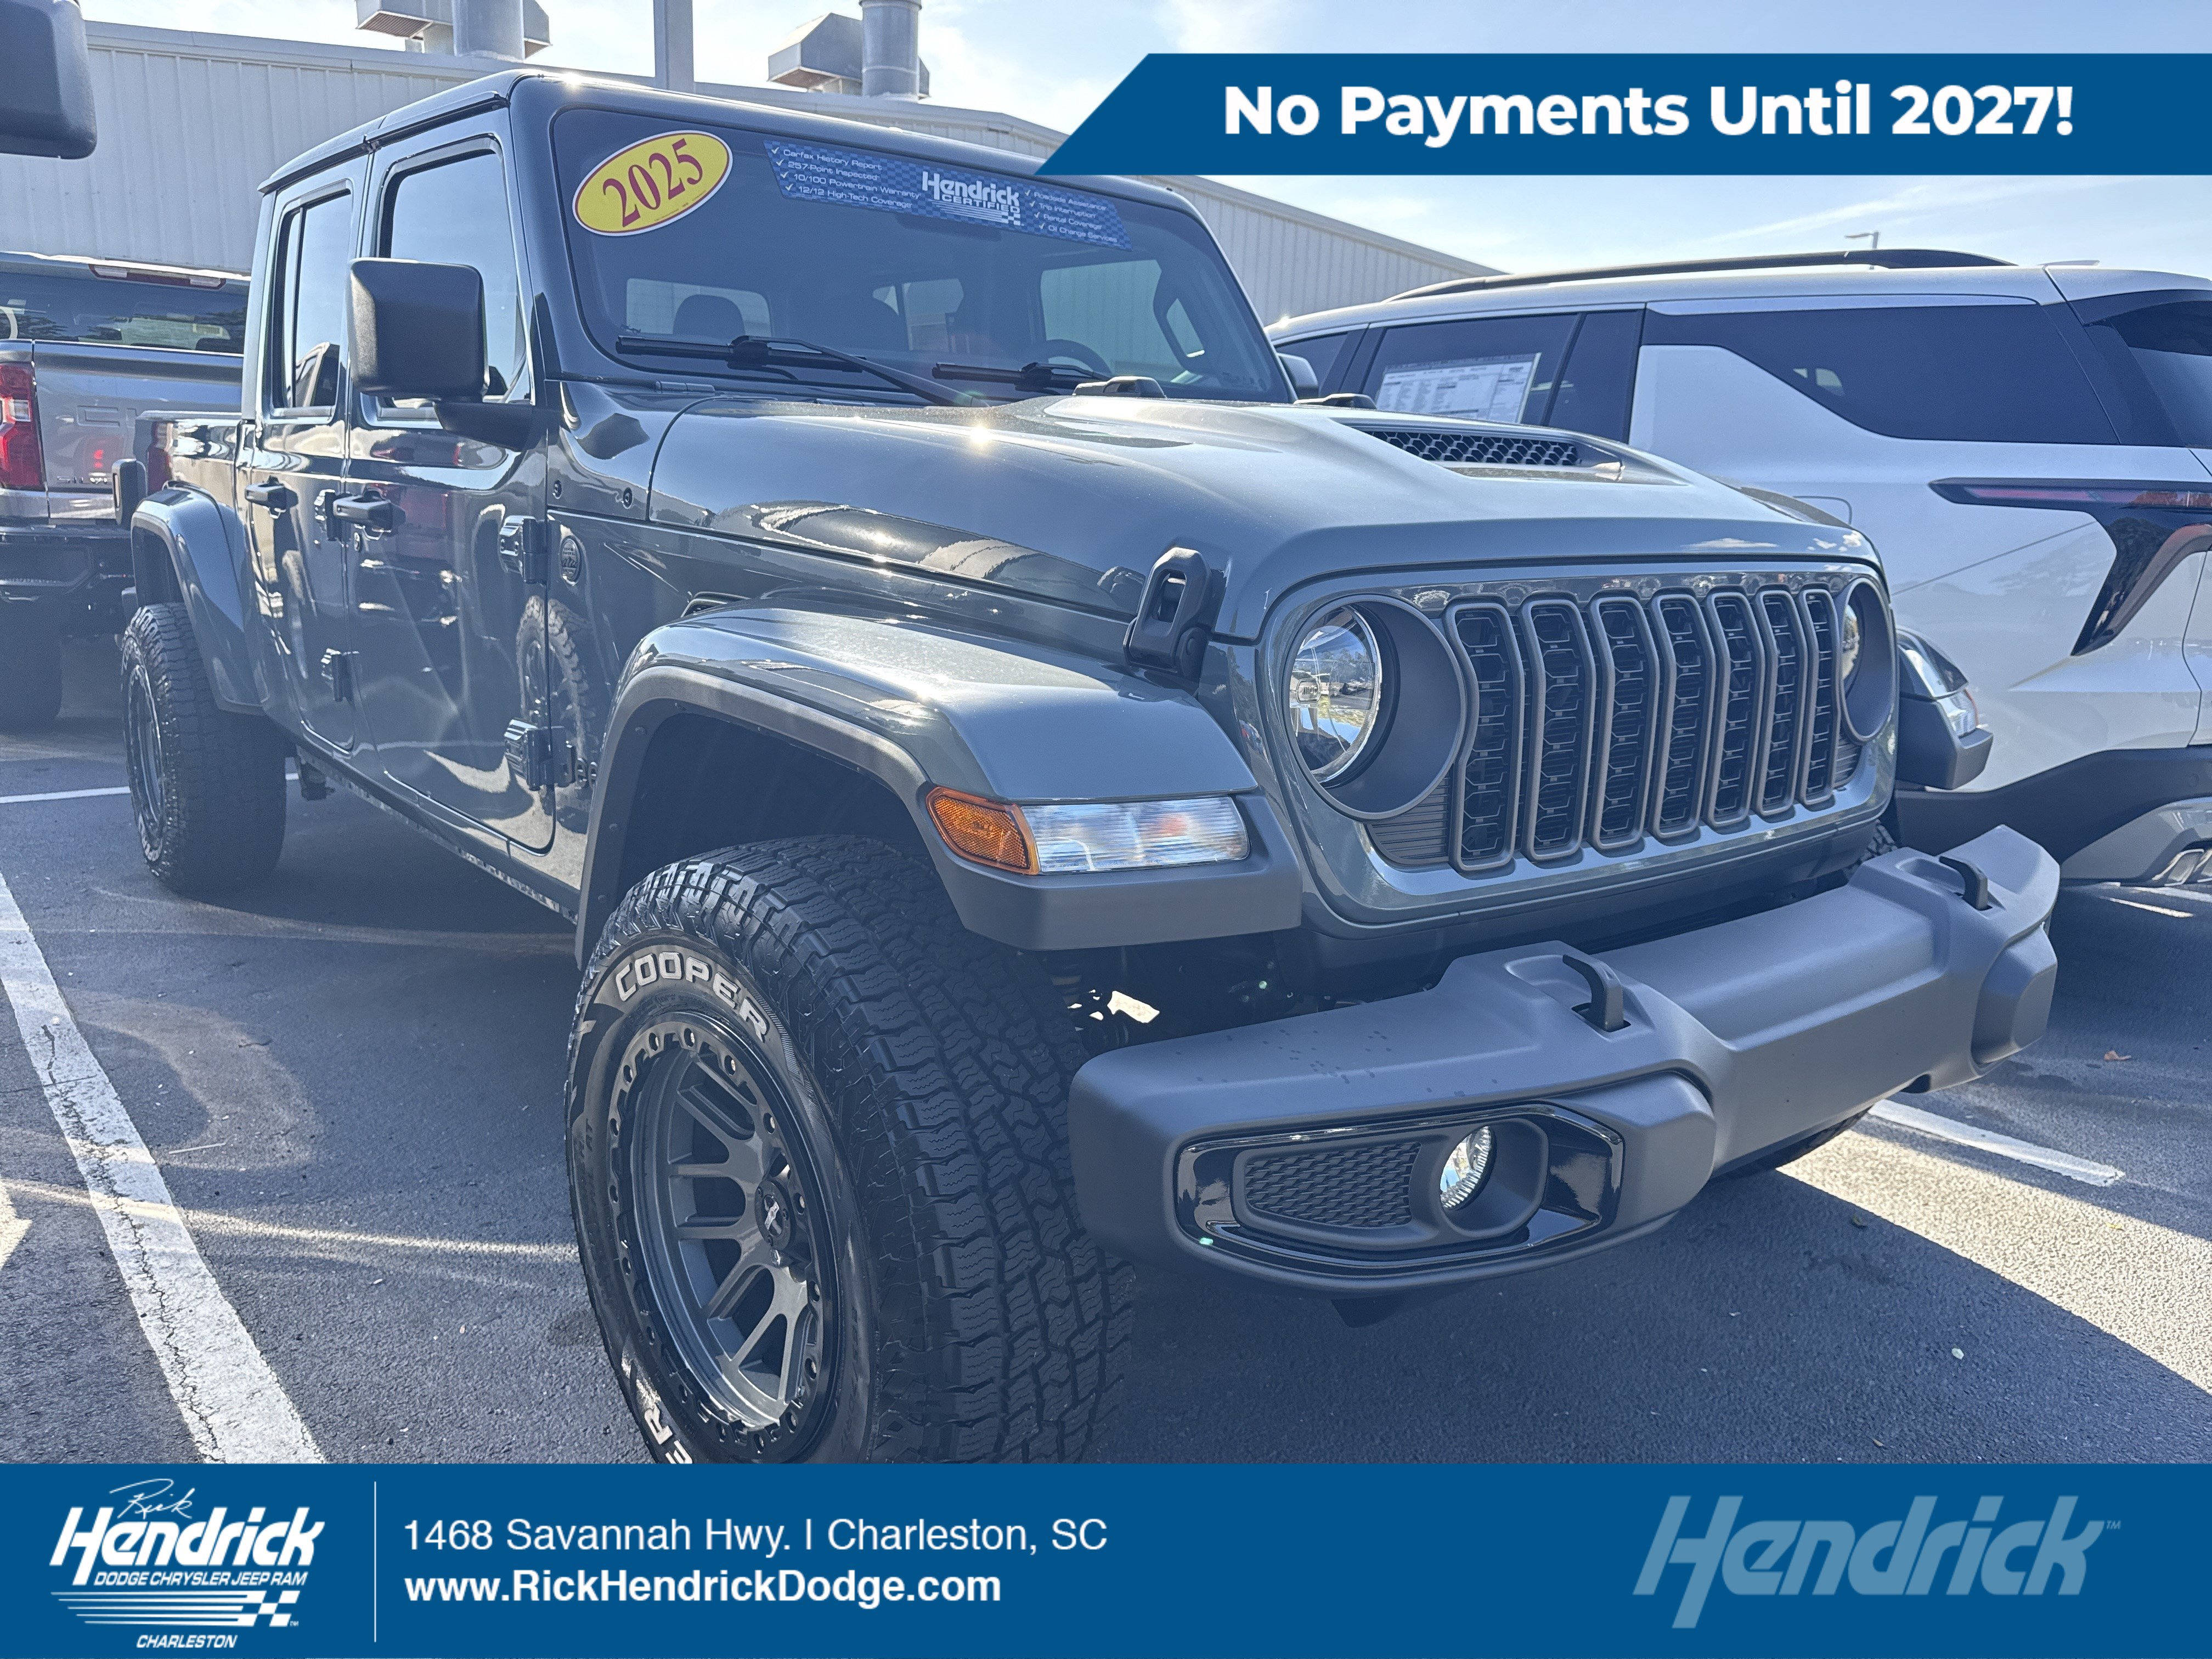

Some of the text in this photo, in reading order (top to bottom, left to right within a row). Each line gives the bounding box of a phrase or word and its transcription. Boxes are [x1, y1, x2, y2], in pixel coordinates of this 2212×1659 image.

[783, 149, 882, 171] Carfax History Report
[603, 138, 703, 228] 2025
[794, 173, 827, 184] 10/100
[829, 179, 878, 192] Powertrain
[798, 185, 825, 196] 12/12
[922, 171, 1020, 207] Hendrick
[941, 194, 1020, 213] CERTIFIED
[616, 952, 769, 1042] COOPER
